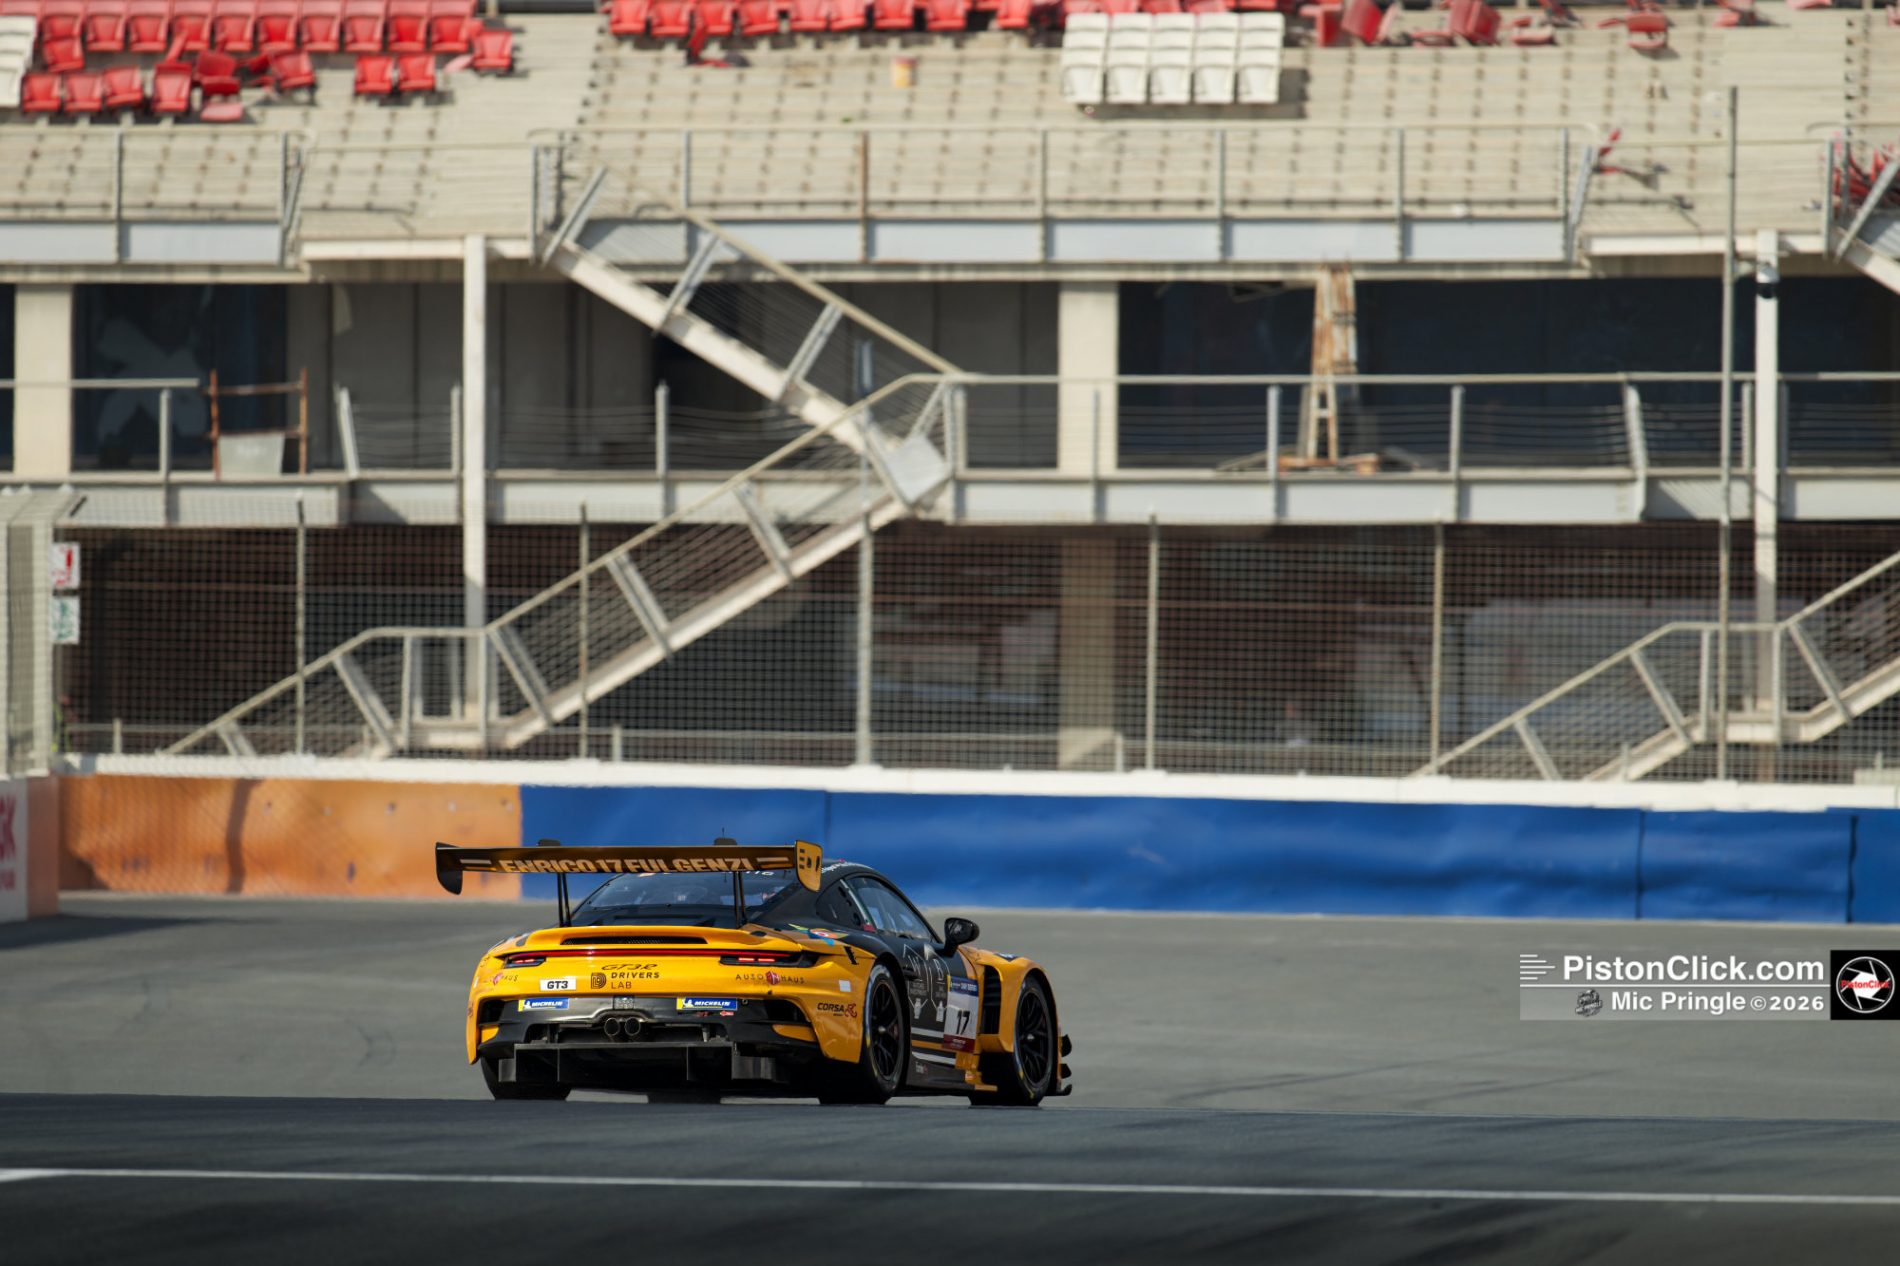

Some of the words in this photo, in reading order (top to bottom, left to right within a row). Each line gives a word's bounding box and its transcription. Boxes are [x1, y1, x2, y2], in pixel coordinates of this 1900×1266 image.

[496, 859, 595, 873] ENRICO
[595, 859, 625, 873] 17
[627, 858, 755, 873] FULGENZI
[547, 980, 569, 990] GT3
[611, 981, 632, 990] LAB
[817, 1002, 845, 1013] CORSA
[956, 1010, 971, 1035] 17
